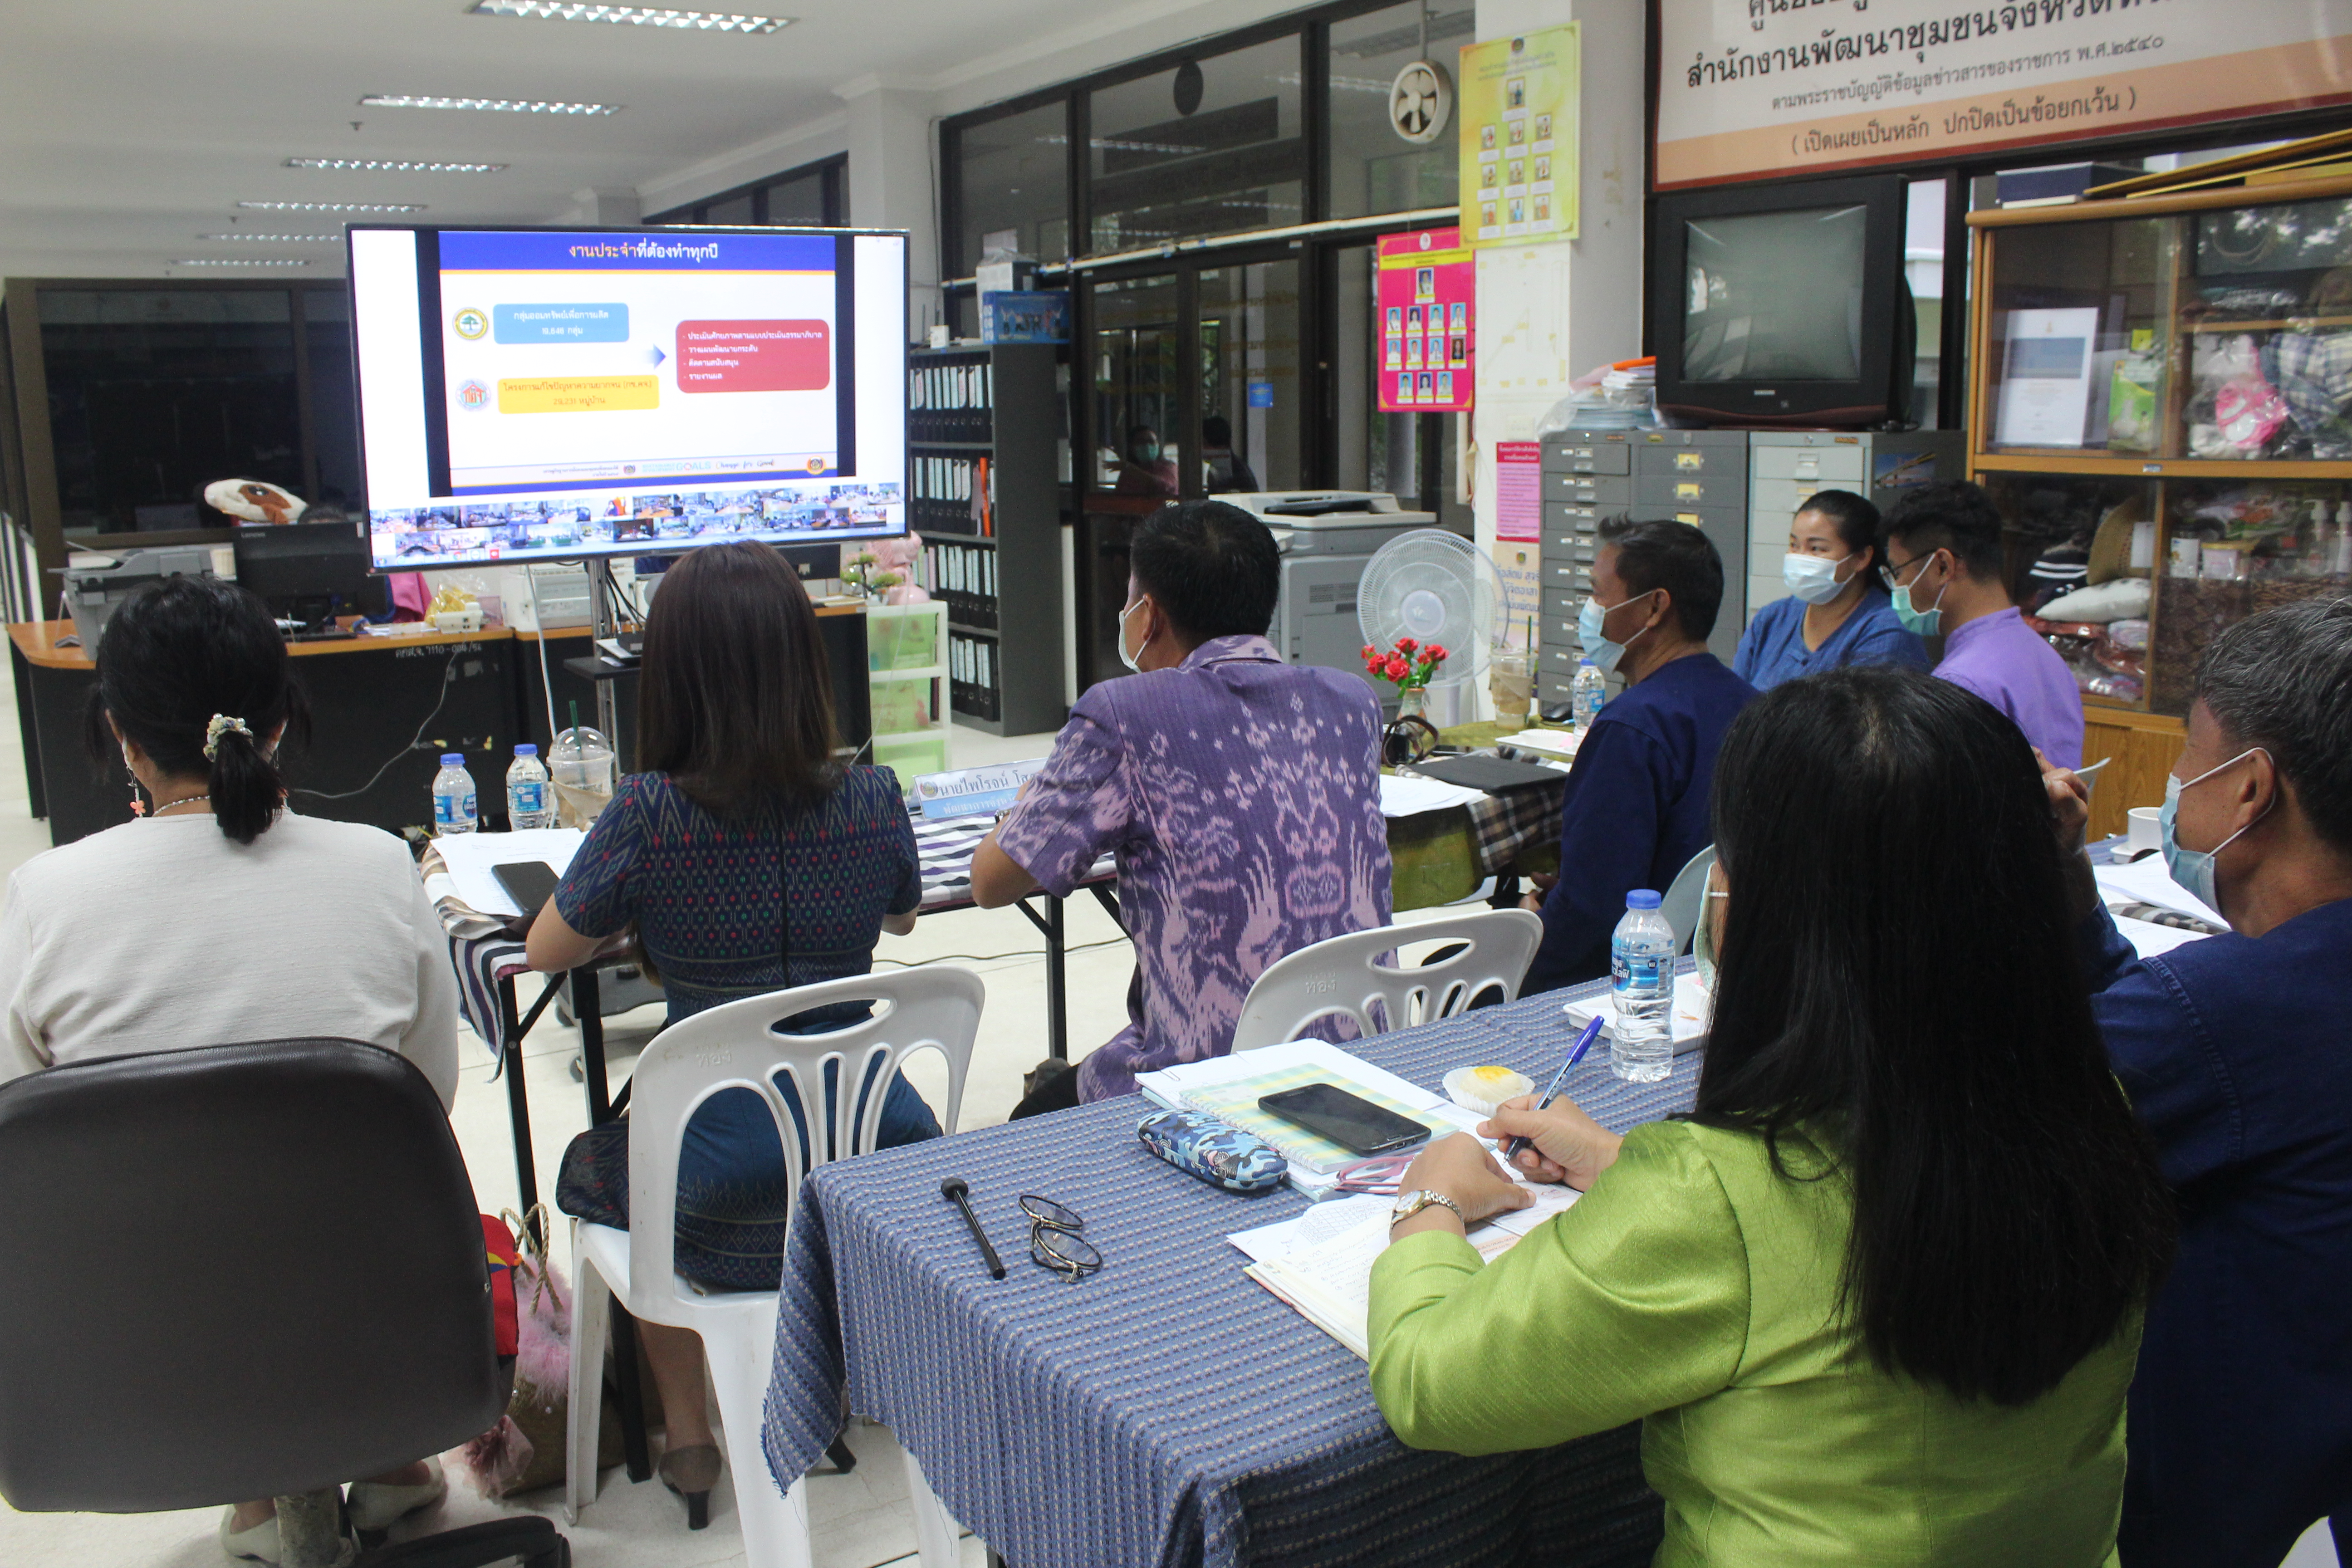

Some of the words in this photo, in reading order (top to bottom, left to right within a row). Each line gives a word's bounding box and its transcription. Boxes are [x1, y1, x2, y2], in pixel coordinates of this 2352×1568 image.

[1772, 48, 2070, 109] ตามพระราชบัญญัติข้อมูลข่าวสารของราชการ
[569, 238, 718, 261] งานประจำที่ต้องทำทุกปี
[514, 308, 609, 322] กลุ่มออมทรัพย์เพื่อการผลิต
[567, 325, 583, 337] กลุ่ม
[578, 396, 606, 407] หมู่บ้าน
[676, 461, 711, 471] GOALS
[938, 770, 1009, 797] นายไพโรจน์
